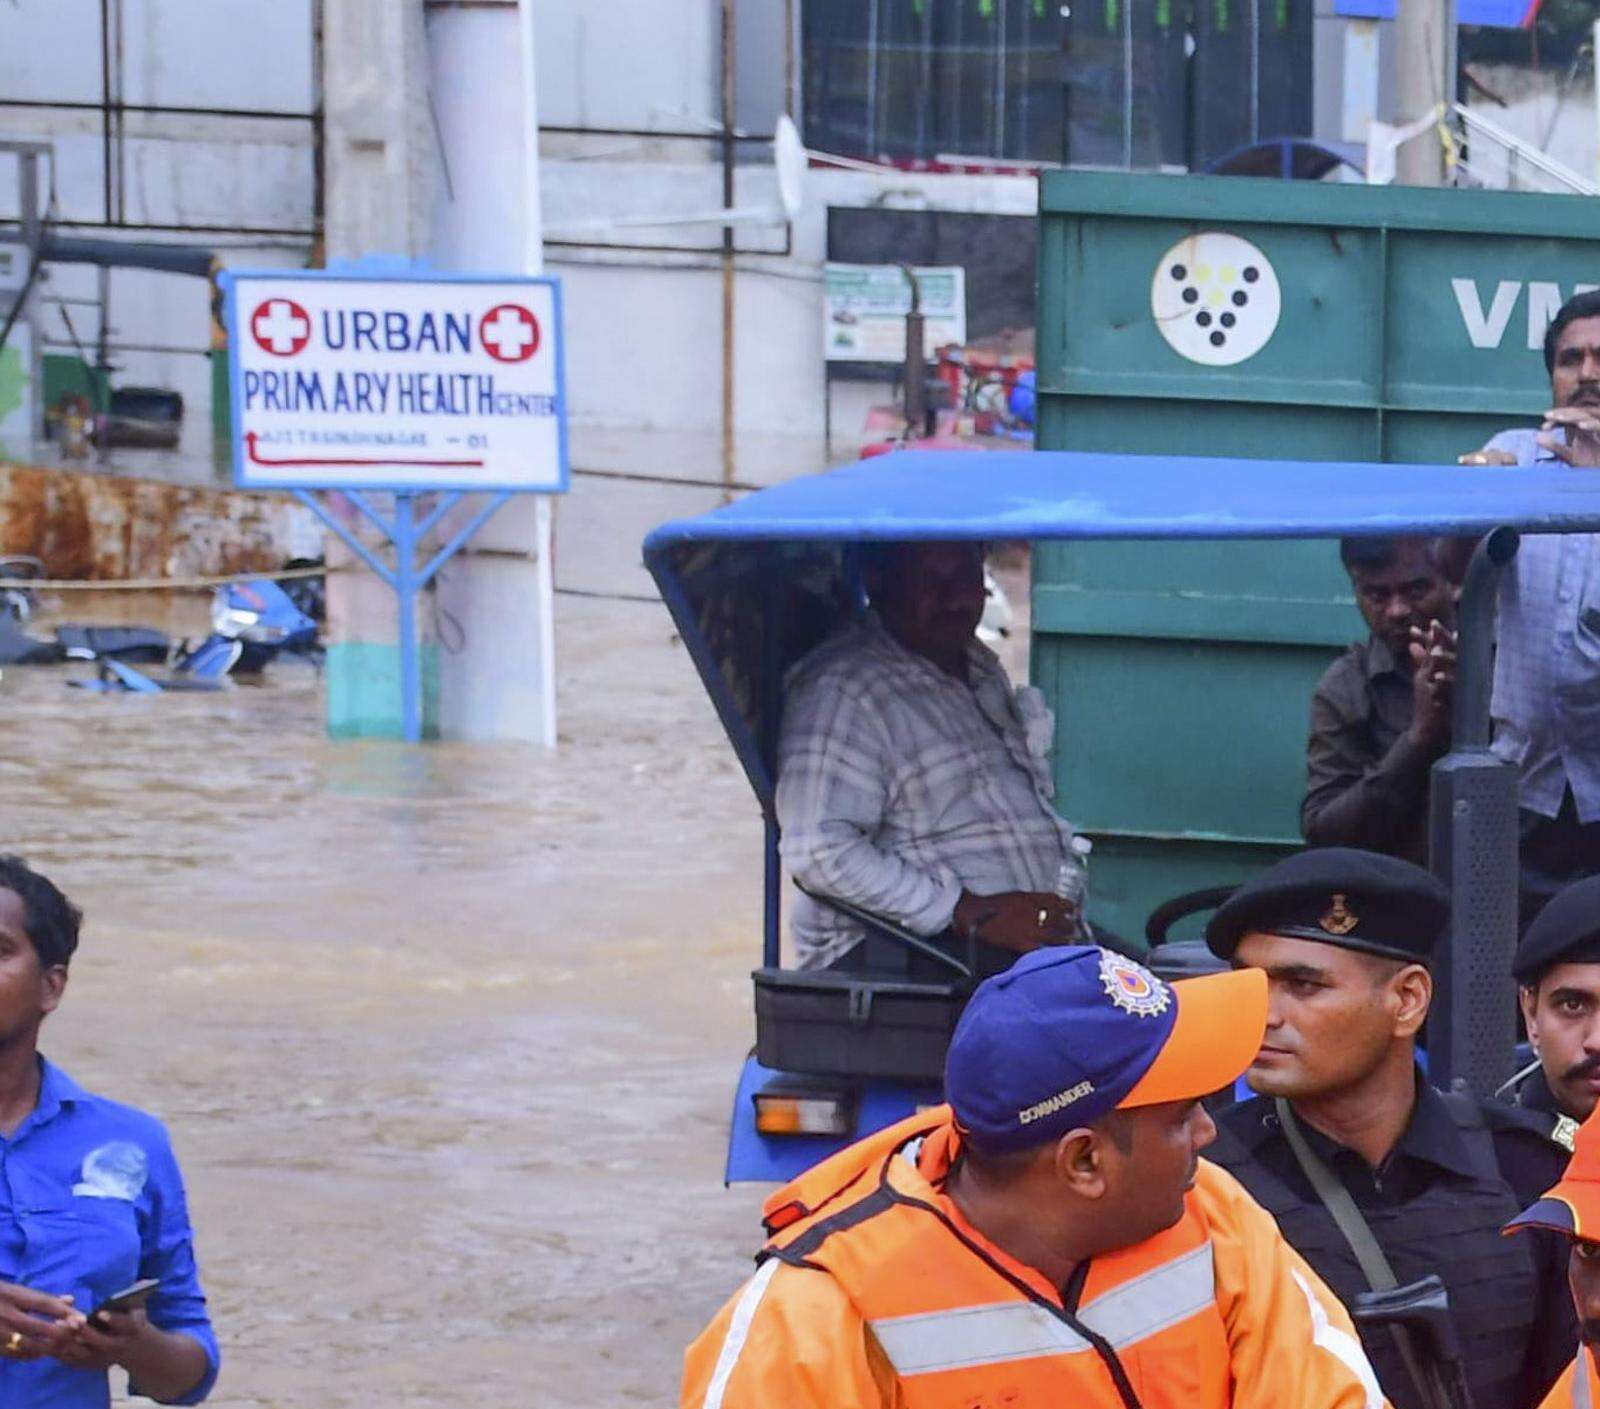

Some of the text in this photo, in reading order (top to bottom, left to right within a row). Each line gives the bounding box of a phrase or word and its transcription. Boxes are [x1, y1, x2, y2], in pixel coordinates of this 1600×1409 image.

[322, 309, 472, 353] URBAN
[244, 369, 390, 415] PRIMARY
[396, 373, 495, 416] HEALTH
